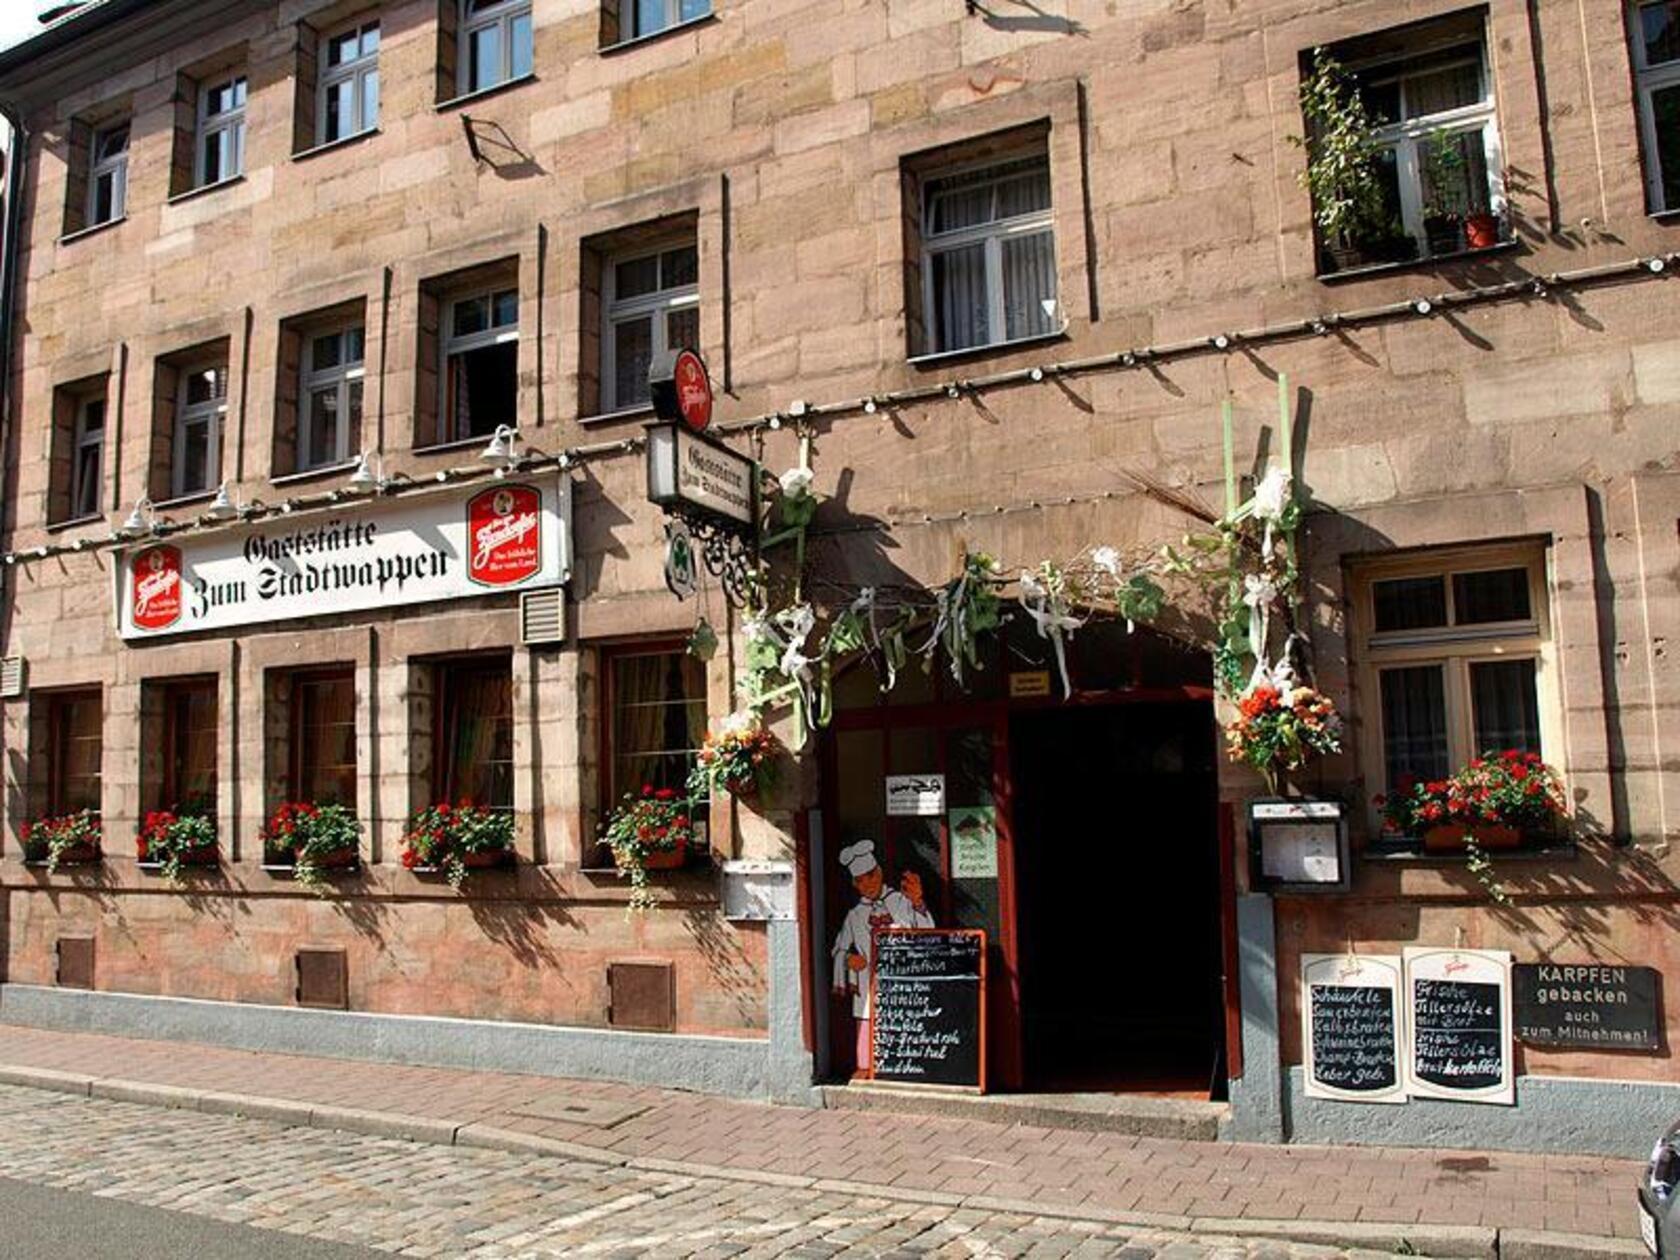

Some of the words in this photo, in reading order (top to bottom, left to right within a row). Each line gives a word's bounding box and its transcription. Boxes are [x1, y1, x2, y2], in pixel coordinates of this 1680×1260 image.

[243, 519, 377, 565] Gaststätte
[190, 576, 247, 618] Zum
[257, 550, 448, 600] Stadtwappen
[1538, 966, 1626, 984] KARPFEN
[1536, 986, 1628, 1005] gebacken
[1564, 1011, 1600, 1023] auch
[1521, 1026, 1551, 1037] zum
[1557, 1026, 1648, 1042] Mitnehmen!
